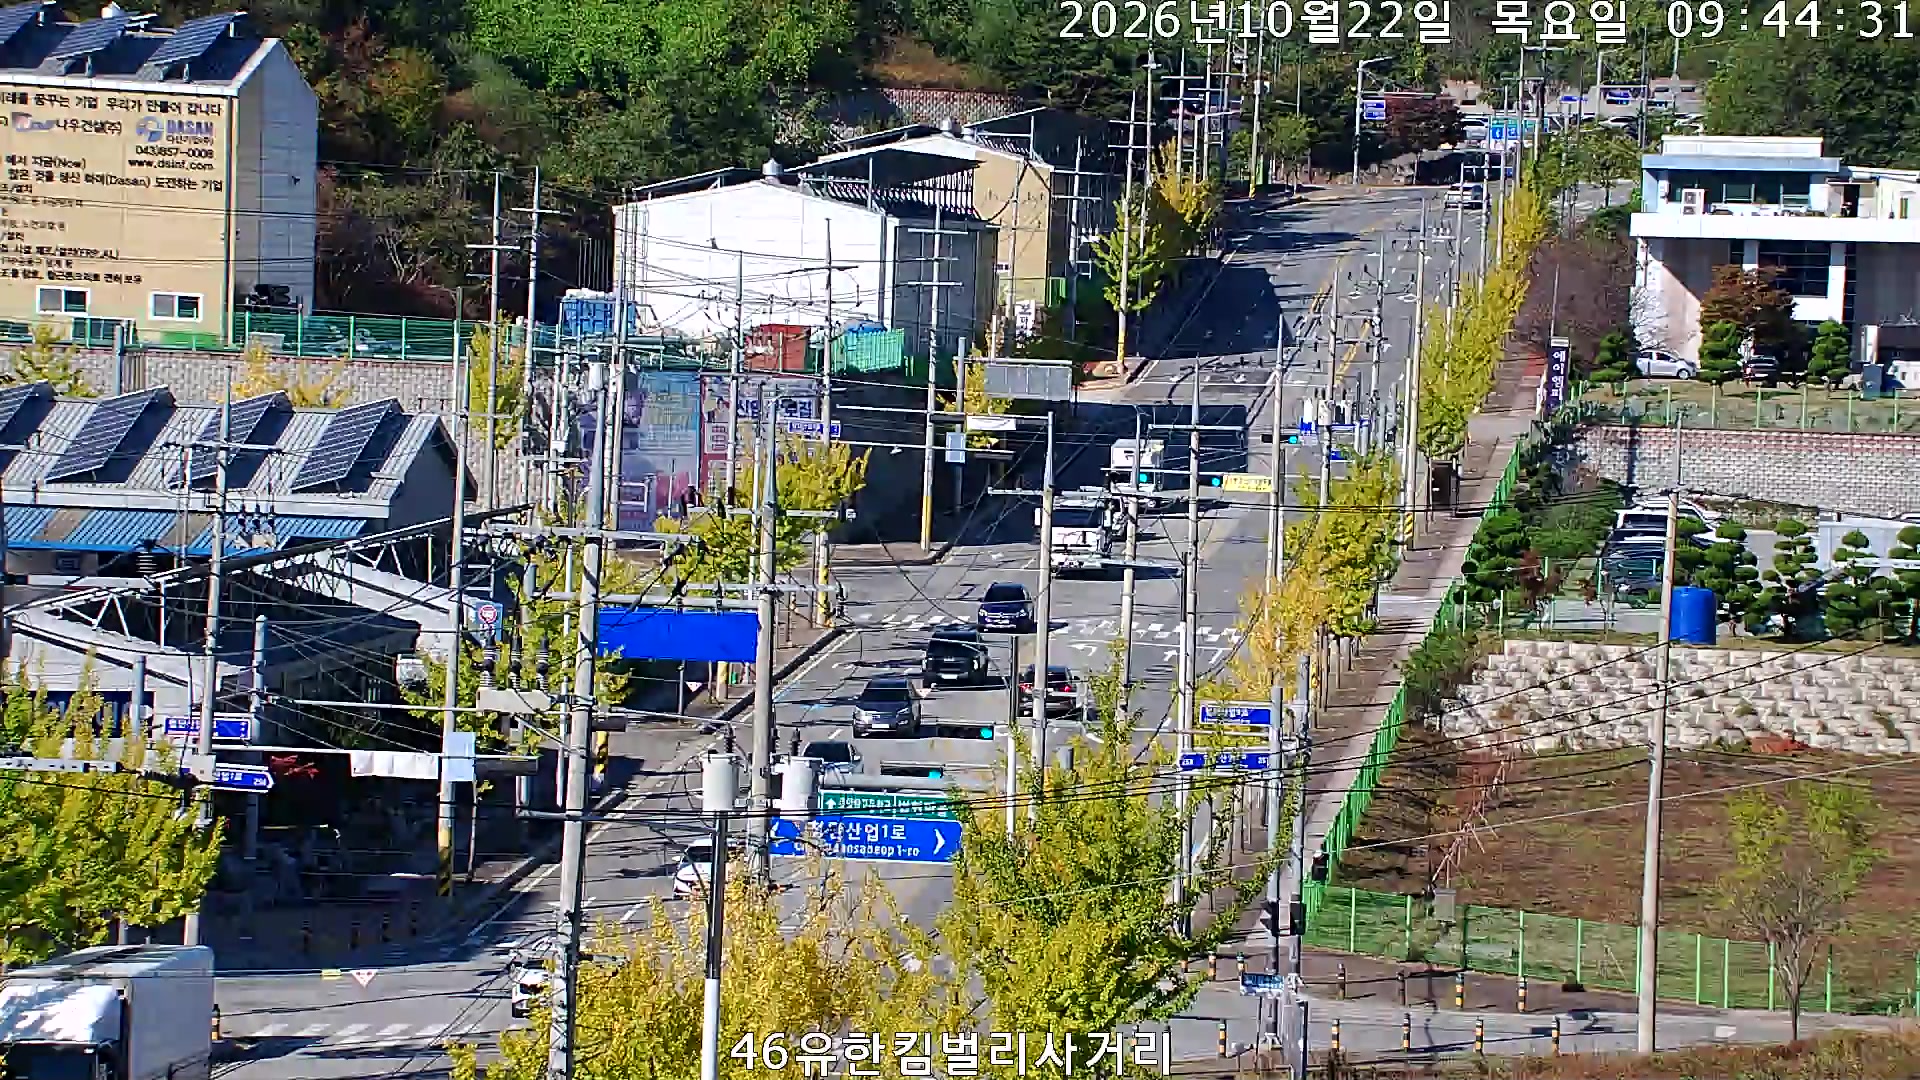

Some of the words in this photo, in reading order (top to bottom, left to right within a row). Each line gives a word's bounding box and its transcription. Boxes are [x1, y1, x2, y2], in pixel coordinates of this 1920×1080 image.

[76, 95, 97, 109] 기업
[106, 97, 141, 112] 우리가
[187, 102, 221, 116] 갑니다
[201, 179, 222, 193] 기업
